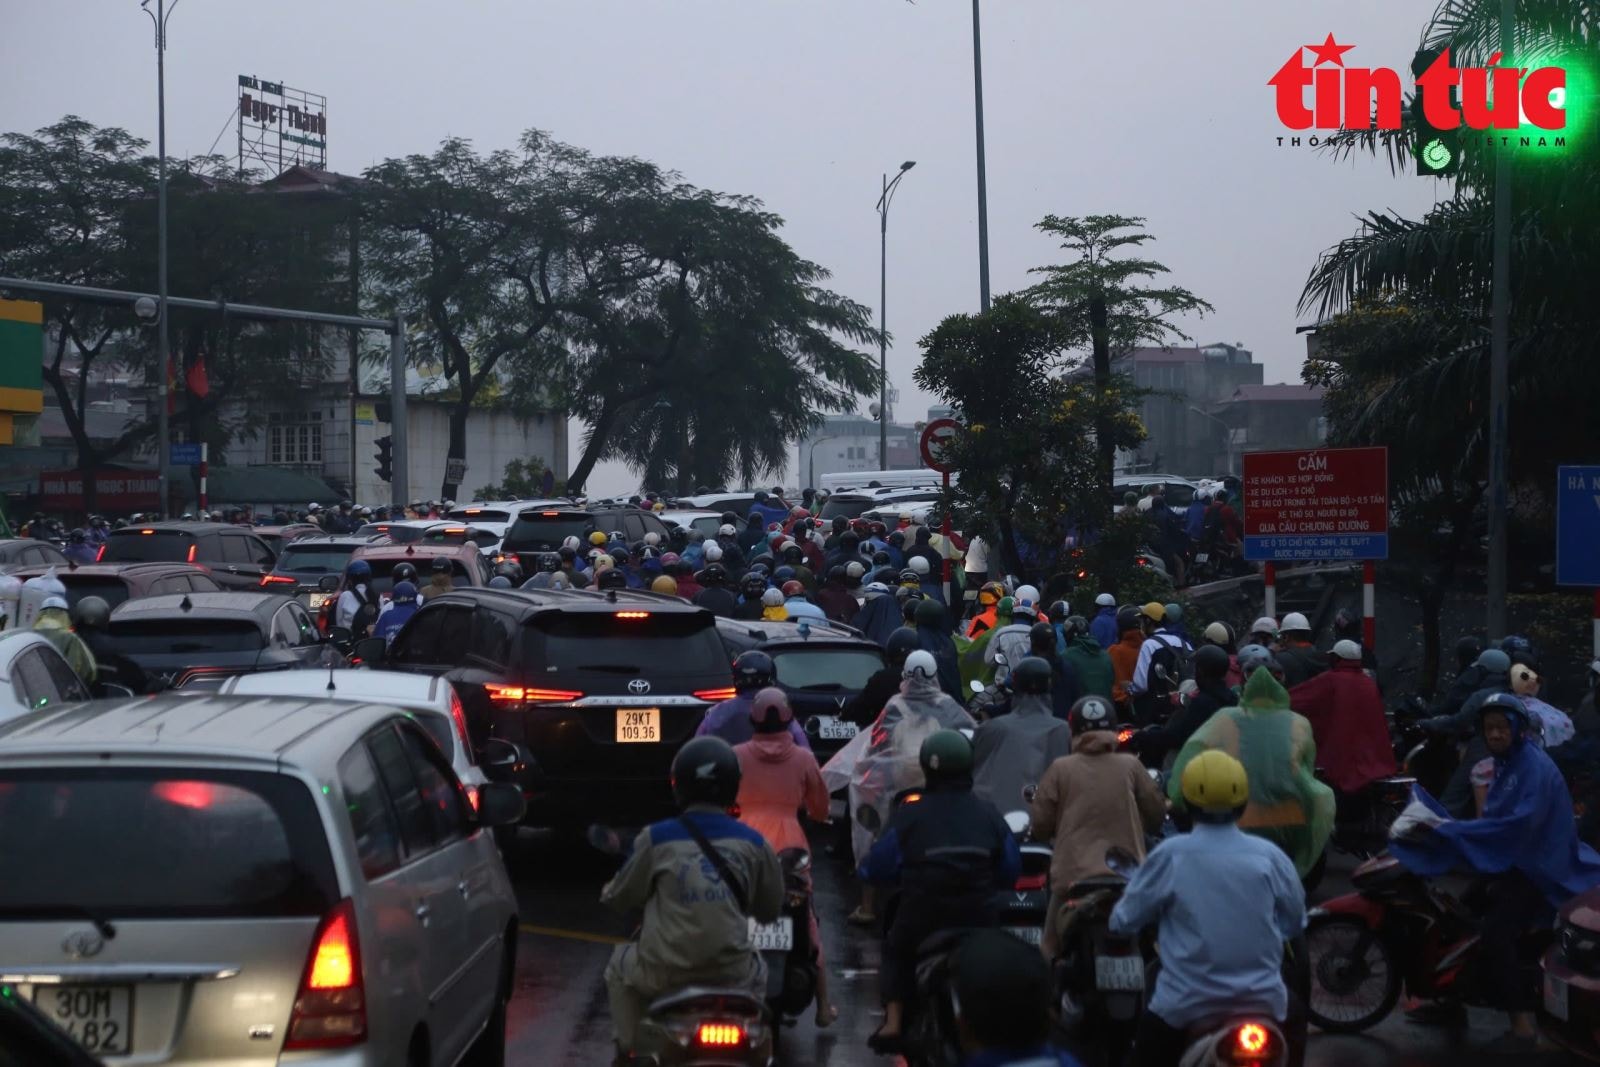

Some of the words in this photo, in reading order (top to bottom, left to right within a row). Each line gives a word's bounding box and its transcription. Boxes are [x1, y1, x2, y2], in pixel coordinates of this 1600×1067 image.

[1297, 450, 1327, 471] CẤM
[1568, 471, 1586, 490] HÀ
[1259, 523, 1276, 533] QUA
[1299, 521, 1335, 531] CHƯƠNG
[625, 712, 651, 725] 29KT
[621, 726, 655, 740] 109.36
[823, 727, 856, 738] 516.28
